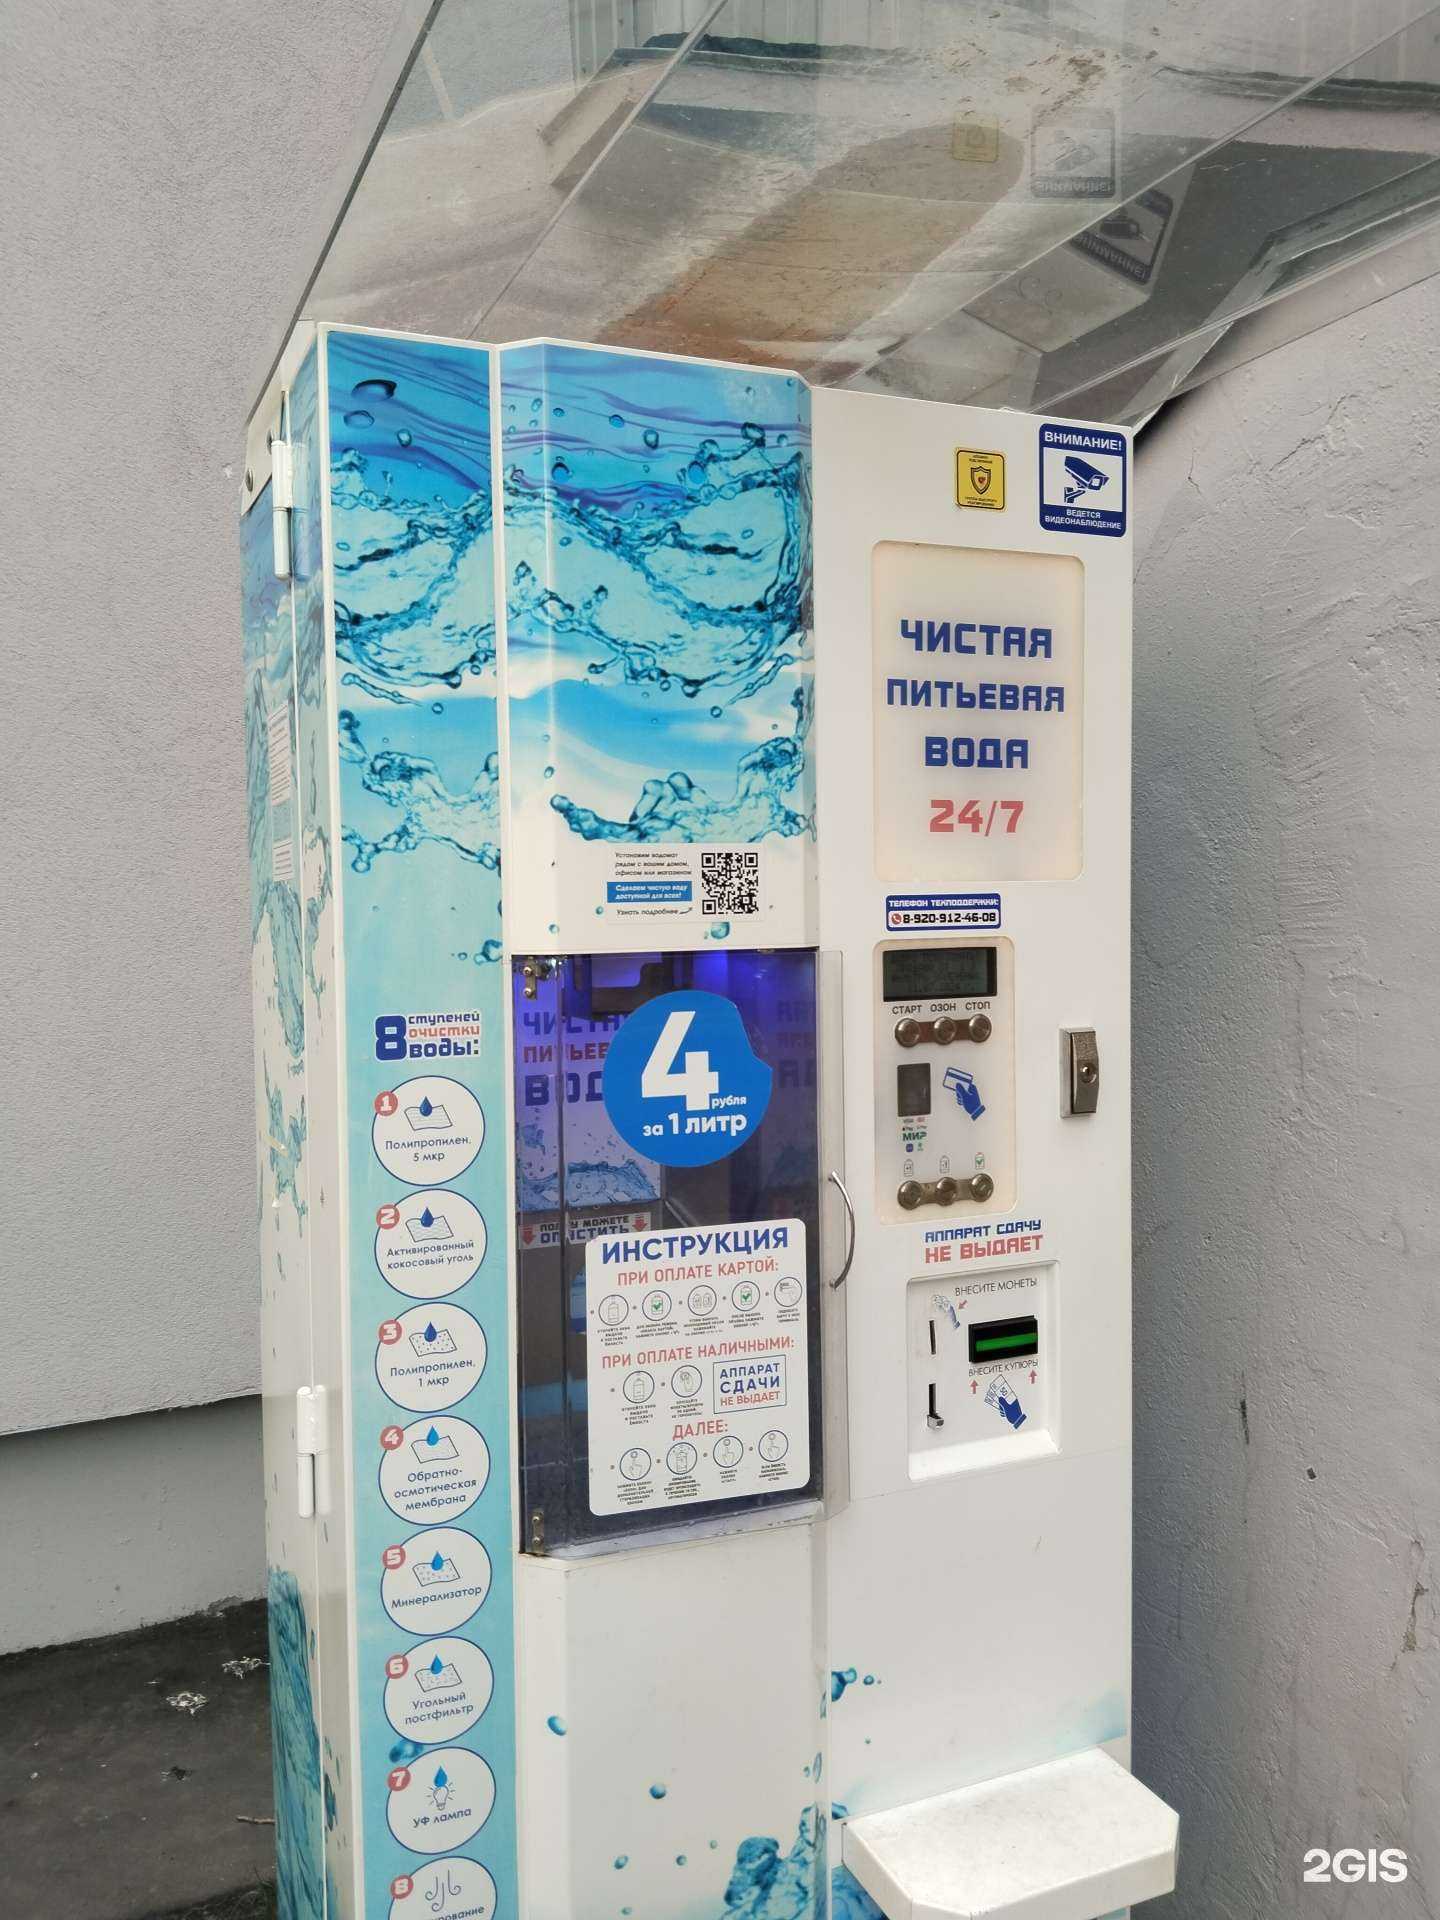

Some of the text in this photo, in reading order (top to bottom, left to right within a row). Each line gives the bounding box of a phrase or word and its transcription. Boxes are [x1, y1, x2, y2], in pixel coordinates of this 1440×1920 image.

[1044, 431, 1122, 451] ВНИМАНИЕ!
[1044, 515, 1122, 530] ВИДЕОНАБЛЮДЕНИЕ
[1066, 509, 1101, 519] ВЕДЕТСЯ
[901, 619, 1053, 659] ЧИСТАЯ
[887, 679, 1065, 712] ПИТЬЕВАЯ
[925, 736, 1029, 769] ВОДА
[930, 800, 1024, 837] 24/7
[888, 900, 929, 908] ТЕЛЕФОН
[903, 912, 996, 924] 8-920-912-46-08
[892, 1001, 991, 1015] СТАРТ ОЗОН СТОП
[375, 1010, 480, 1061] 8 ступеней
[408, 1025, 480, 1039] очистки
[409, 1037, 479, 1059] воды:
[641, 1010, 720, 1111] 4
[525, 1070, 604, 1106] ВОД
[380, 1095, 392, 1112] 1
[711, 1094, 747, 1110] рубля
[642, 1112, 747, 1137] за 1 литр
[902, 1131, 928, 1141] МИР
[413, 1152, 445, 1162] 5 мкр
[380, 1208, 395, 1225] 2
[925, 1219, 1042, 1243] АППАРАТ СДАЧУ
[387, 1239, 475, 1257] Активированный
[602, 1226, 789, 1265] ИНСТРУКЦИЯ
[925, 1234, 1043, 1264] НЕ ВЫДАЕТ
[387, 1254, 474, 1270] кокосовый уголь
[617, 1256, 779, 1286] ПРИ ОПЛАТЕ КАРТОЙ:
[955, 1277, 1038, 1297] ВНЕСИТЕ МОНЕТЫ
[382, 1323, 397, 1341] 3
[602, 1336, 795, 1369] ПРИ ОПЛАТЕ НАЛИЧНЫМИ:
[720, 1362, 780, 1379] АППАРАТ
[968, 1358, 1039, 1377] ВНЕСИТЕ КУПЮРЫ
[427, 1376, 450, 1387] мкр
[720, 1375, 780, 1395] СДАЧИ
[720, 1390, 780, 1407] НЕ ВЫДАЕТ
[384, 1429, 399, 1445] 4
[672, 1419, 729, 1441] ДАЛЕЕ:
[407, 1467, 463, 1483] Обратно-
[394, 1478, 477, 1499] осмотическая
[405, 1493, 467, 1511] мембрана
[386, 1549, 401, 1566] 5
[391, 1586, 482, 1609] Минерализатор
[390, 1657, 404, 1675] 6
[412, 1691, 466, 1710] Угольный
[405, 1703, 474, 1726] постфильтр
[392, 1770, 406, 1787] 7
[433, 1807, 472, 1824] лампа
[396, 1878, 409, 1896] 8
